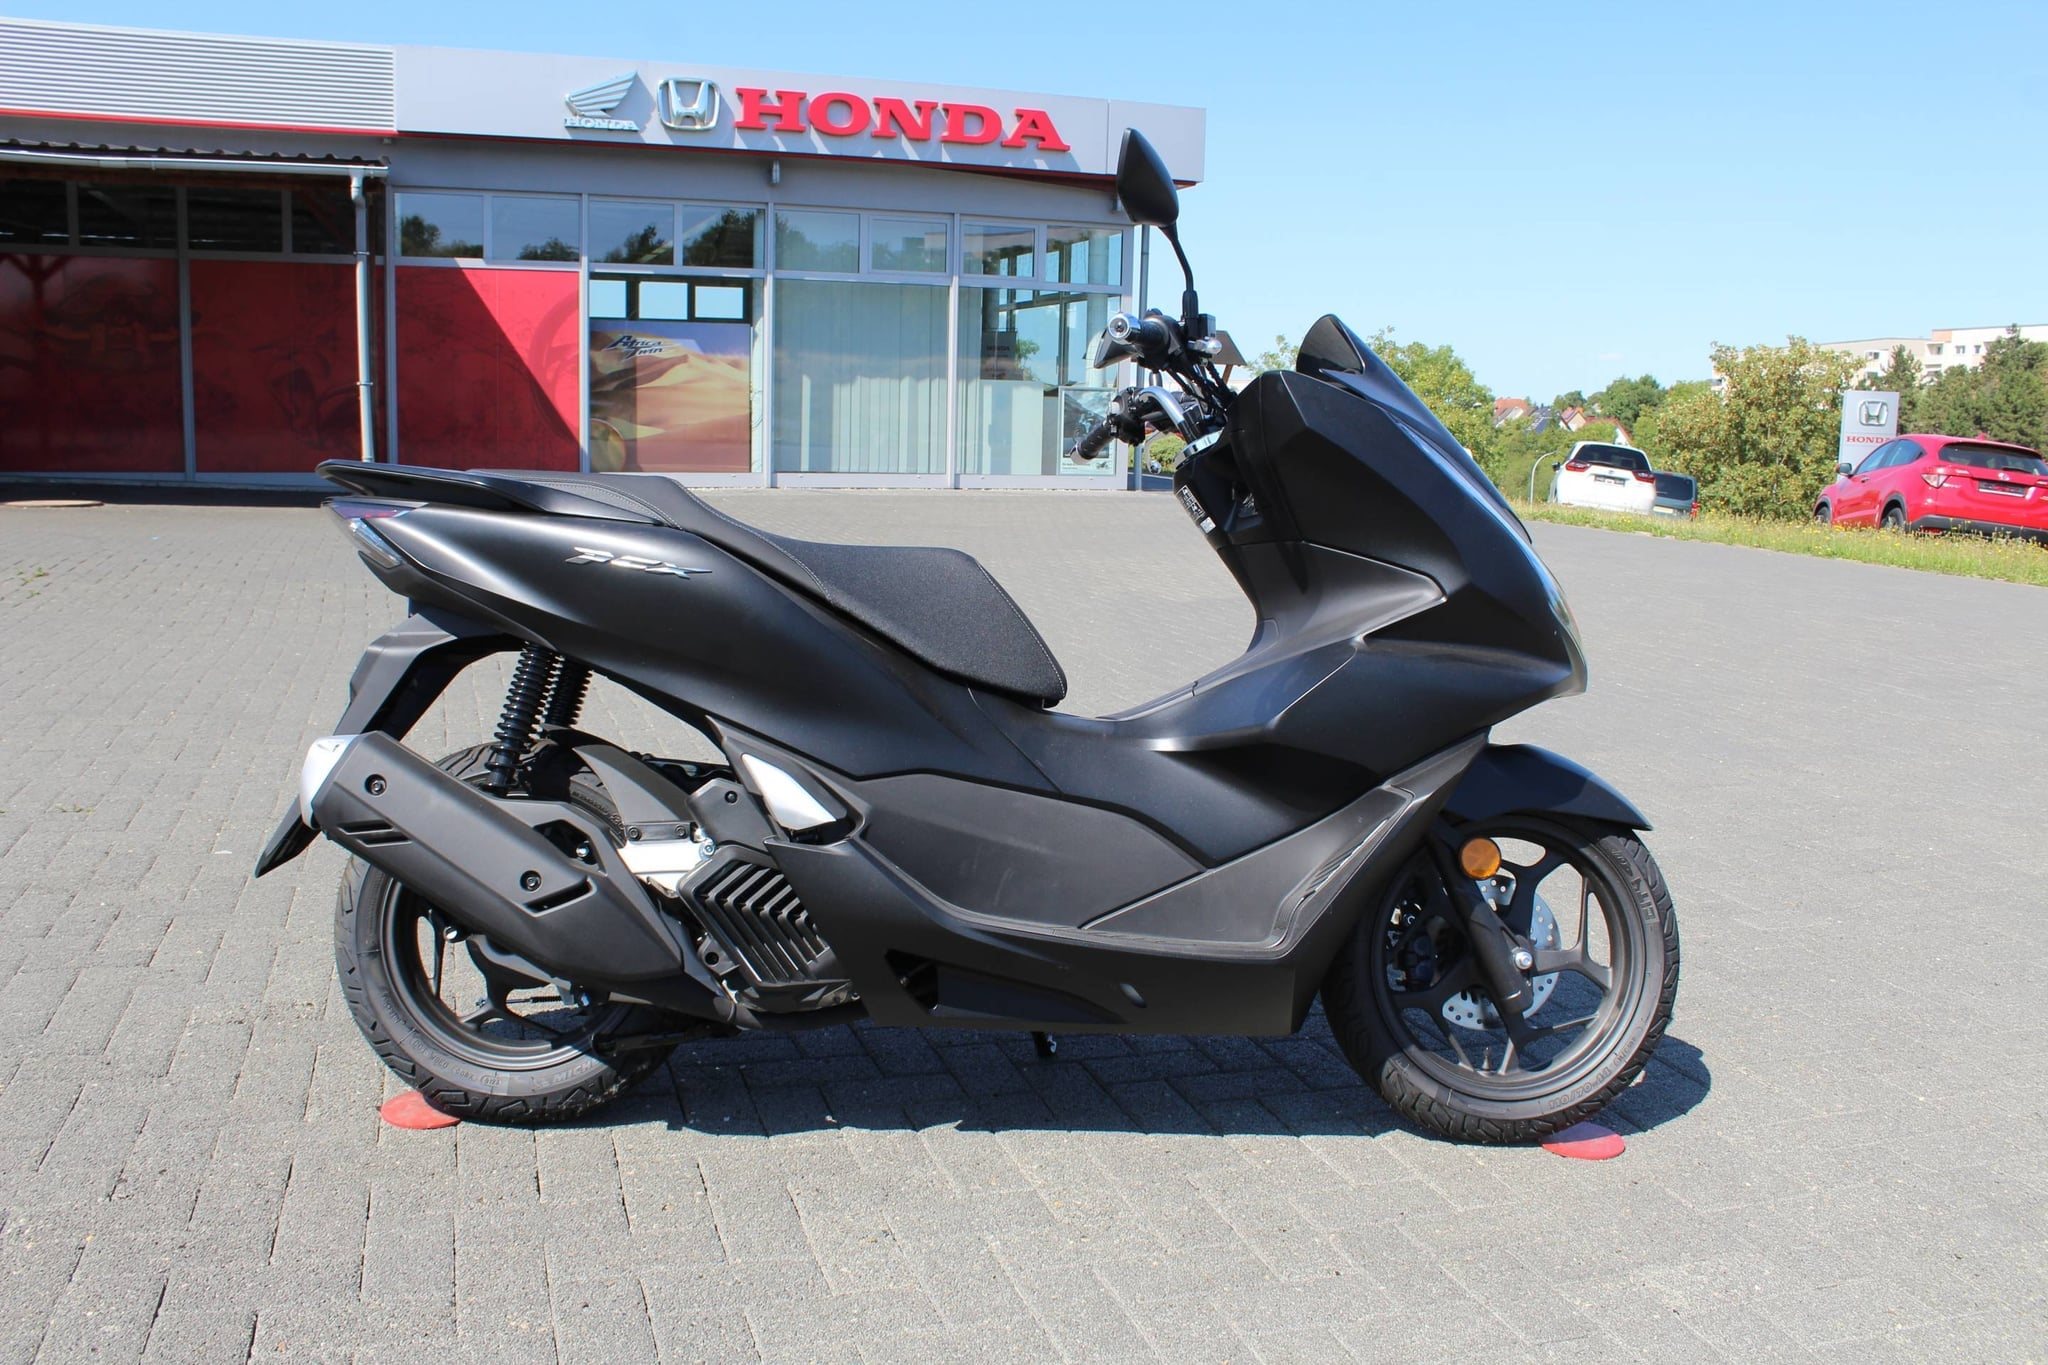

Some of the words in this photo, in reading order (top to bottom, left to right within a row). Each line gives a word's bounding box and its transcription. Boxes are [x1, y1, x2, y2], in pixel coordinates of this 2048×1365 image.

[564, 117, 639, 132] HONDA
[734, 87, 1070, 152] HONDA
[607, 335, 663, 349] Africa
[626, 346, 663, 360] Twin
[1846, 436, 1891, 444] HOND
